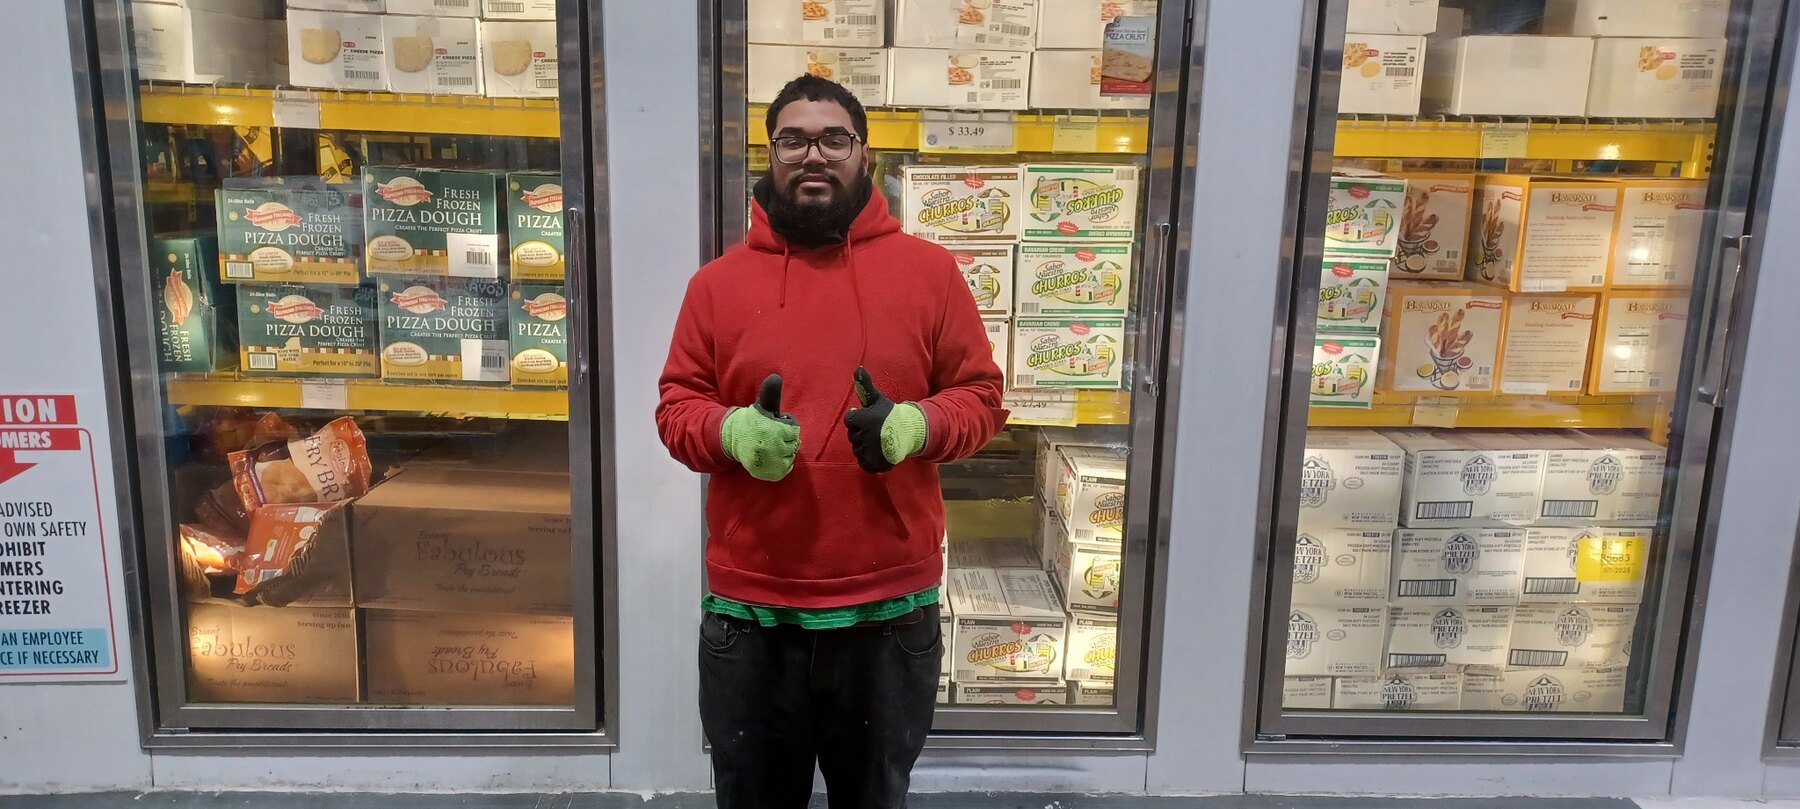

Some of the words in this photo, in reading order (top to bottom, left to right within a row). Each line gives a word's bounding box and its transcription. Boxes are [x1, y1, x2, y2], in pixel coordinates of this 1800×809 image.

[949, 127, 954, 136] $
[958, 127, 984, 136] 33.49
[444, 188, 480, 200] FRESH
[436, 199, 480, 210] FROZEN
[918, 195, 974, 223] CHURROS
[1066, 188, 1124, 216] CHURROS
[308, 213, 340, 223] FRESH
[372, 208, 416, 222] PIZZA
[420, 210, 482, 226] DOUGH
[518, 214, 562, 229] PIZZA
[302, 222, 342, 233] FROZEN
[244, 232, 284, 244] PIZZA
[288, 234, 344, 246] DOUGH
[1032, 268, 1088, 295] CHURROS
[458, 296, 494, 306] FRESH
[330, 305, 362, 315] FRESH
[451, 306, 494, 317] FROZEN
[324, 315, 362, 324] FROZEN
[387, 316, 430, 329] PIZZA
[435, 318, 496, 332] DOUGH
[266, 324, 305, 336] PIZZA
[310, 325, 364, 338] DOUGH
[518, 324, 561, 336] PIZZA
[170, 324, 182, 362] FROZEN
[180, 330, 192, 361] FRESH
[1026, 341, 1082, 368] CHURROS
[0, 431, 52, 448] MERS
[304, 436, 326, 466] FRY
[1313, 470, 1330, 478] YORK
[4, 522, 36, 537] OWN
[41, 522, 86, 537] SAFETY
[416, 540, 526, 565] Fabulous
[1305, 547, 1322, 555] YORK
[455, 563, 474, 578] Fry
[478, 564, 522, 577] Breads
[1297, 623, 1313, 631] YORK
[2, 632, 18, 646] AN
[22, 631, 84, 646] EMPLOYEE
[192, 636, 296, 659] Fabulous
[431, 647, 475, 658] Breads
[479, 645, 499, 659] Fry
[967, 639, 1023, 663] CHURROS
[18, 651, 28, 665] IF
[33, 650, 99, 665] NECESSARY
[226, 658, 246, 672] Fry
[250, 659, 293, 672] Breads
[428, 658, 536, 681] Fabulous
[1525, 695, 1560, 703] PRETZEL
